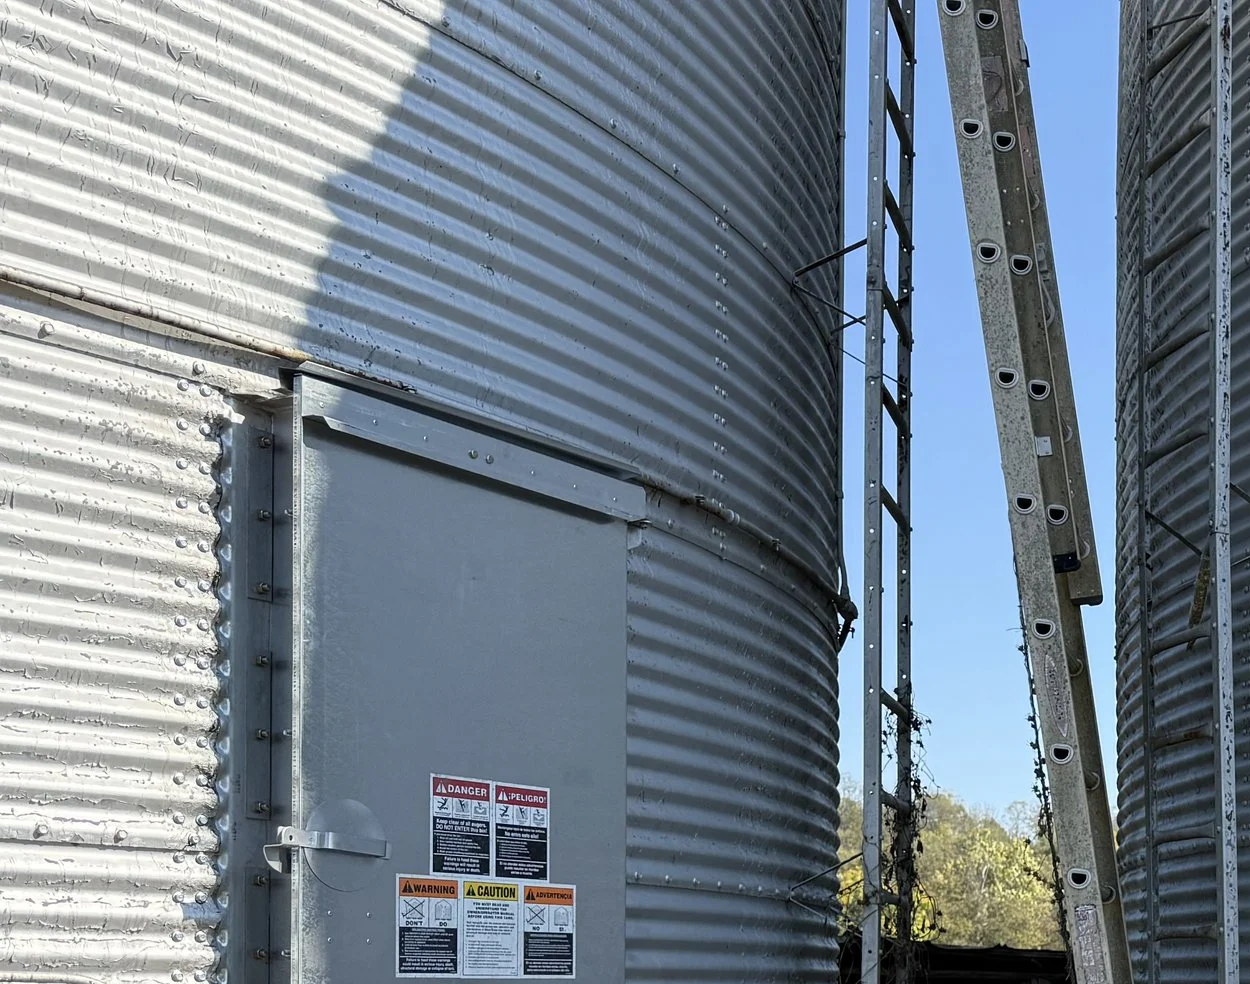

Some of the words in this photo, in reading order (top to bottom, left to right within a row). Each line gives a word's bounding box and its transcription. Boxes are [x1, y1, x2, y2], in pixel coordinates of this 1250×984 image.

[448, 785, 487, 797] DANGER
[509, 793, 547, 804] ¡PELIGRO!
[413, 884, 455, 895] WARNING
[478, 886, 516, 898] CAUTION
[536, 892, 572, 900] ADVERTENCIA
